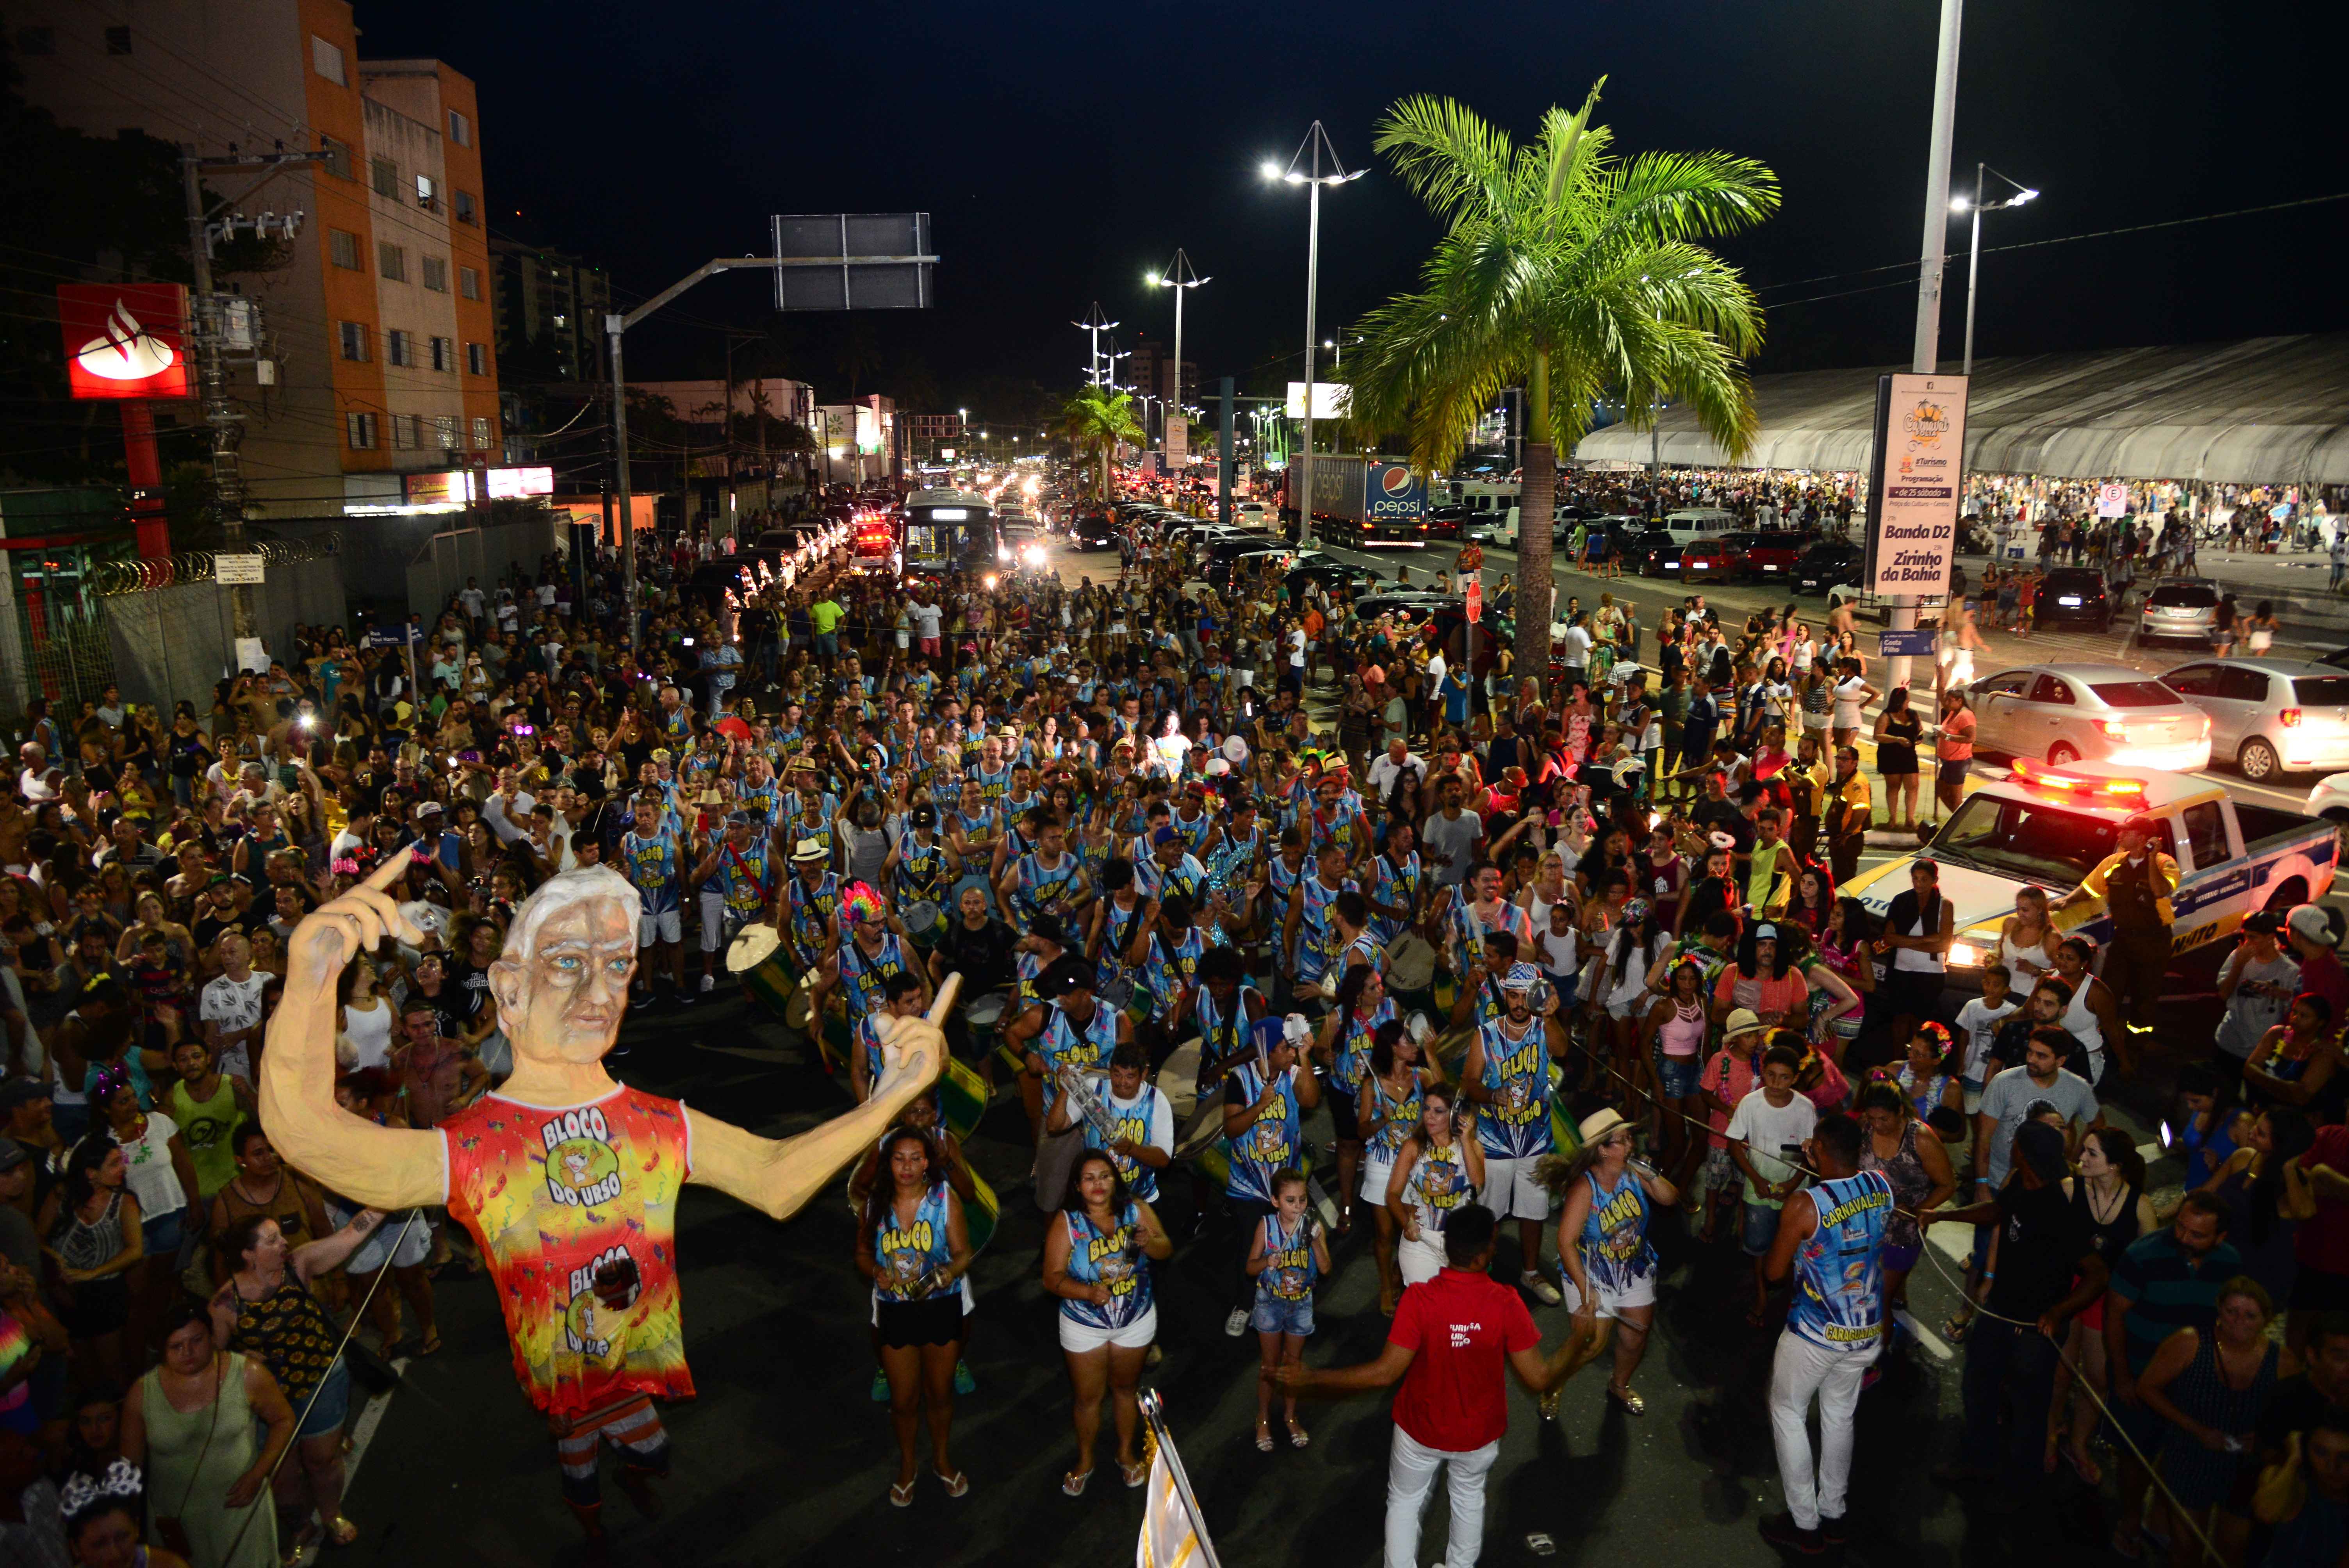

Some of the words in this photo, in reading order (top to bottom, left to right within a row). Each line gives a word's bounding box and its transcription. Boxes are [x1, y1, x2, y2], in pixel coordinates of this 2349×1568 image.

[1916, 457, 1947, 465] #Turismo
[1901, 475, 1943, 484] Programação
[1916, 488, 1941, 496] sábado
[1374, 499, 1420, 513] pepsi
[1885, 524, 1929, 538] Banda
[1932, 525, 1950, 538] D2
[1893, 550, 1942, 566] Zirinho
[1881, 567, 1899, 581] da
[1901, 566, 1941, 581] Bahia
[1468, 595, 1481, 609] PARE
[637, 846, 663, 864] BLOCO
[1501, 1042, 1540, 1081] BLOCO
[1517, 1099, 1542, 1125] URSO
[542, 1107, 608, 1150] BLOCO
[1267, 1142, 1289, 1164] URSO
[550, 1179, 581, 1207] DO
[579, 1170, 622, 1208] URSO
[1434, 1190, 1460, 1208] URSO
[1598, 1187, 1641, 1233] BLOCO
[1822, 1194, 1873, 1229] CARNAVAL
[1871, 1192, 1890, 1207] 2017
